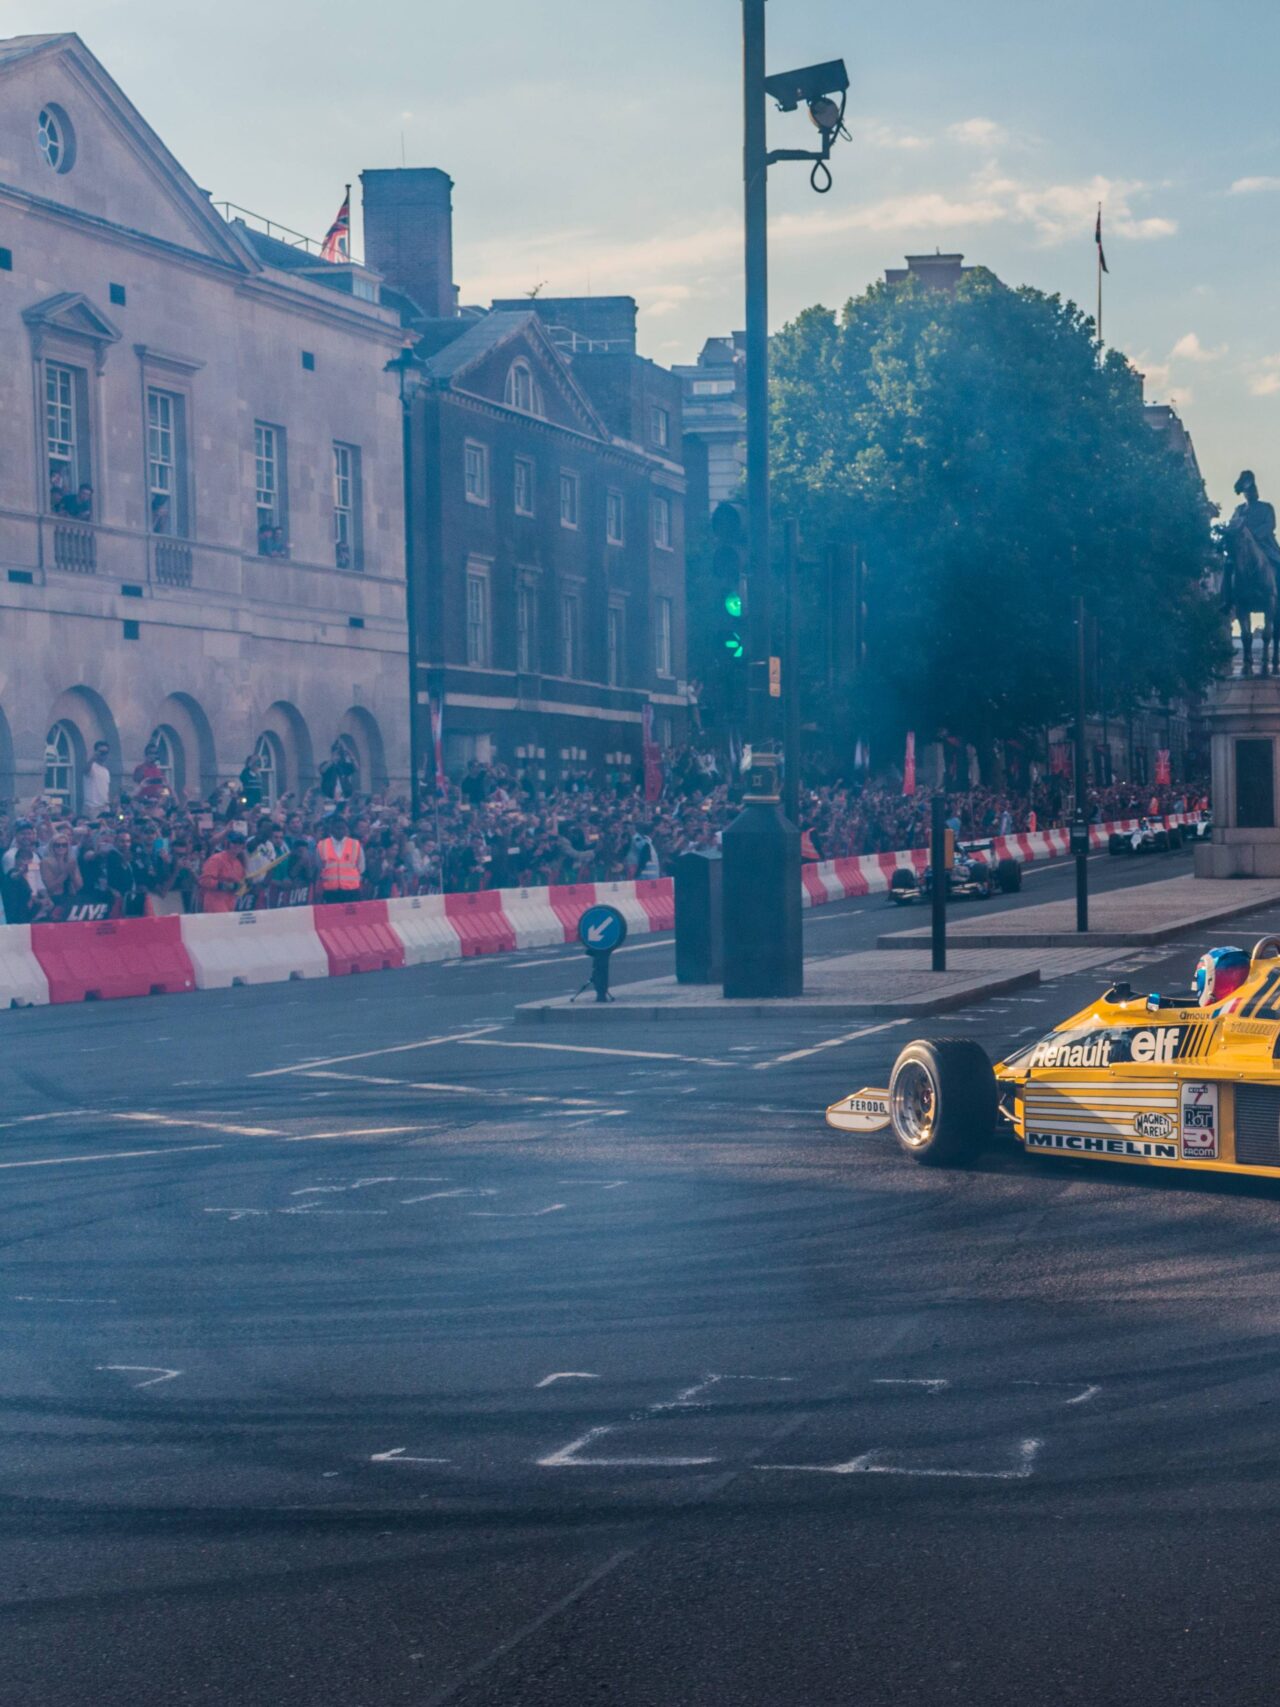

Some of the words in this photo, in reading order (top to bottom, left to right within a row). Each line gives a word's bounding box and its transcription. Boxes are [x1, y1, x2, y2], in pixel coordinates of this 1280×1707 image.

[66, 903, 109, 921] LIVE
[1029, 1038, 1112, 1068] Renault
[1130, 1027, 1180, 1063] elf
[850, 1100, 886, 1113] FERODO
[1028, 1132, 1176, 1158] MICHELIN
